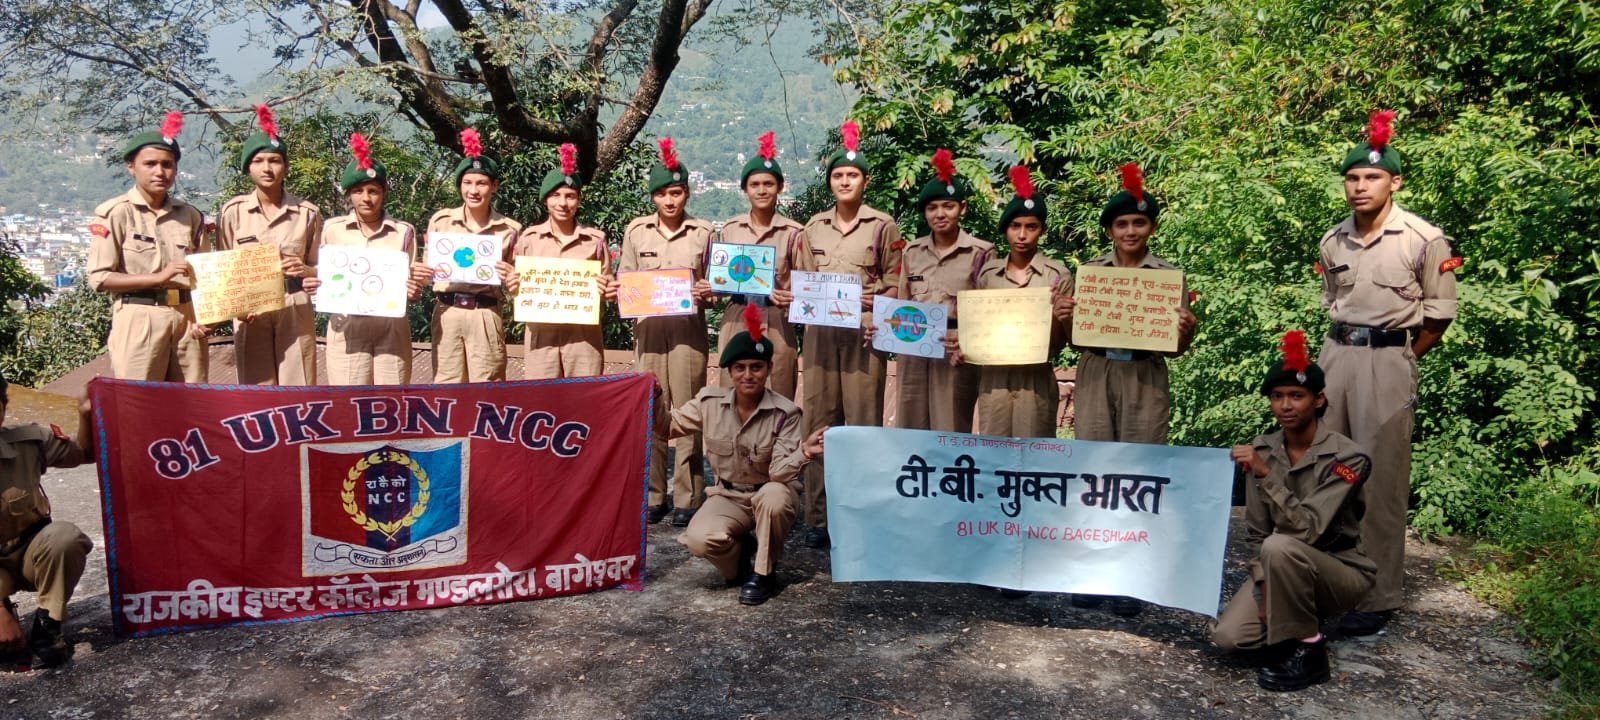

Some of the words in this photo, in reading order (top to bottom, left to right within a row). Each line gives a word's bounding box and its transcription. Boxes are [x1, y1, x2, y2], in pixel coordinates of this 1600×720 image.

[1442, 259, 1459, 269] NCC
[148, 428, 220, 480] 81
[221, 399, 341, 453] UK
[351, 396, 461, 437] BN
[469, 402, 591, 458] NCC
[1336, 465, 1355, 481] NCC
[995, 470, 1077, 517] मुक्त
[1080, 473, 1170, 514] भारत
[957, 522, 973, 538] 81
[978, 521, 1000, 536] UK
[1004, 522, 1021, 537] BN
[1027, 526, 1058, 542] NCC
[1062, 527, 1151, 545] BAGESHWAR
[122, 579, 243, 624] राजकीय
[243, 585, 315, 618] इण्टर
[316, 574, 411, 610] कॉलेज
[545, 553, 637, 593] बागेश्वर
